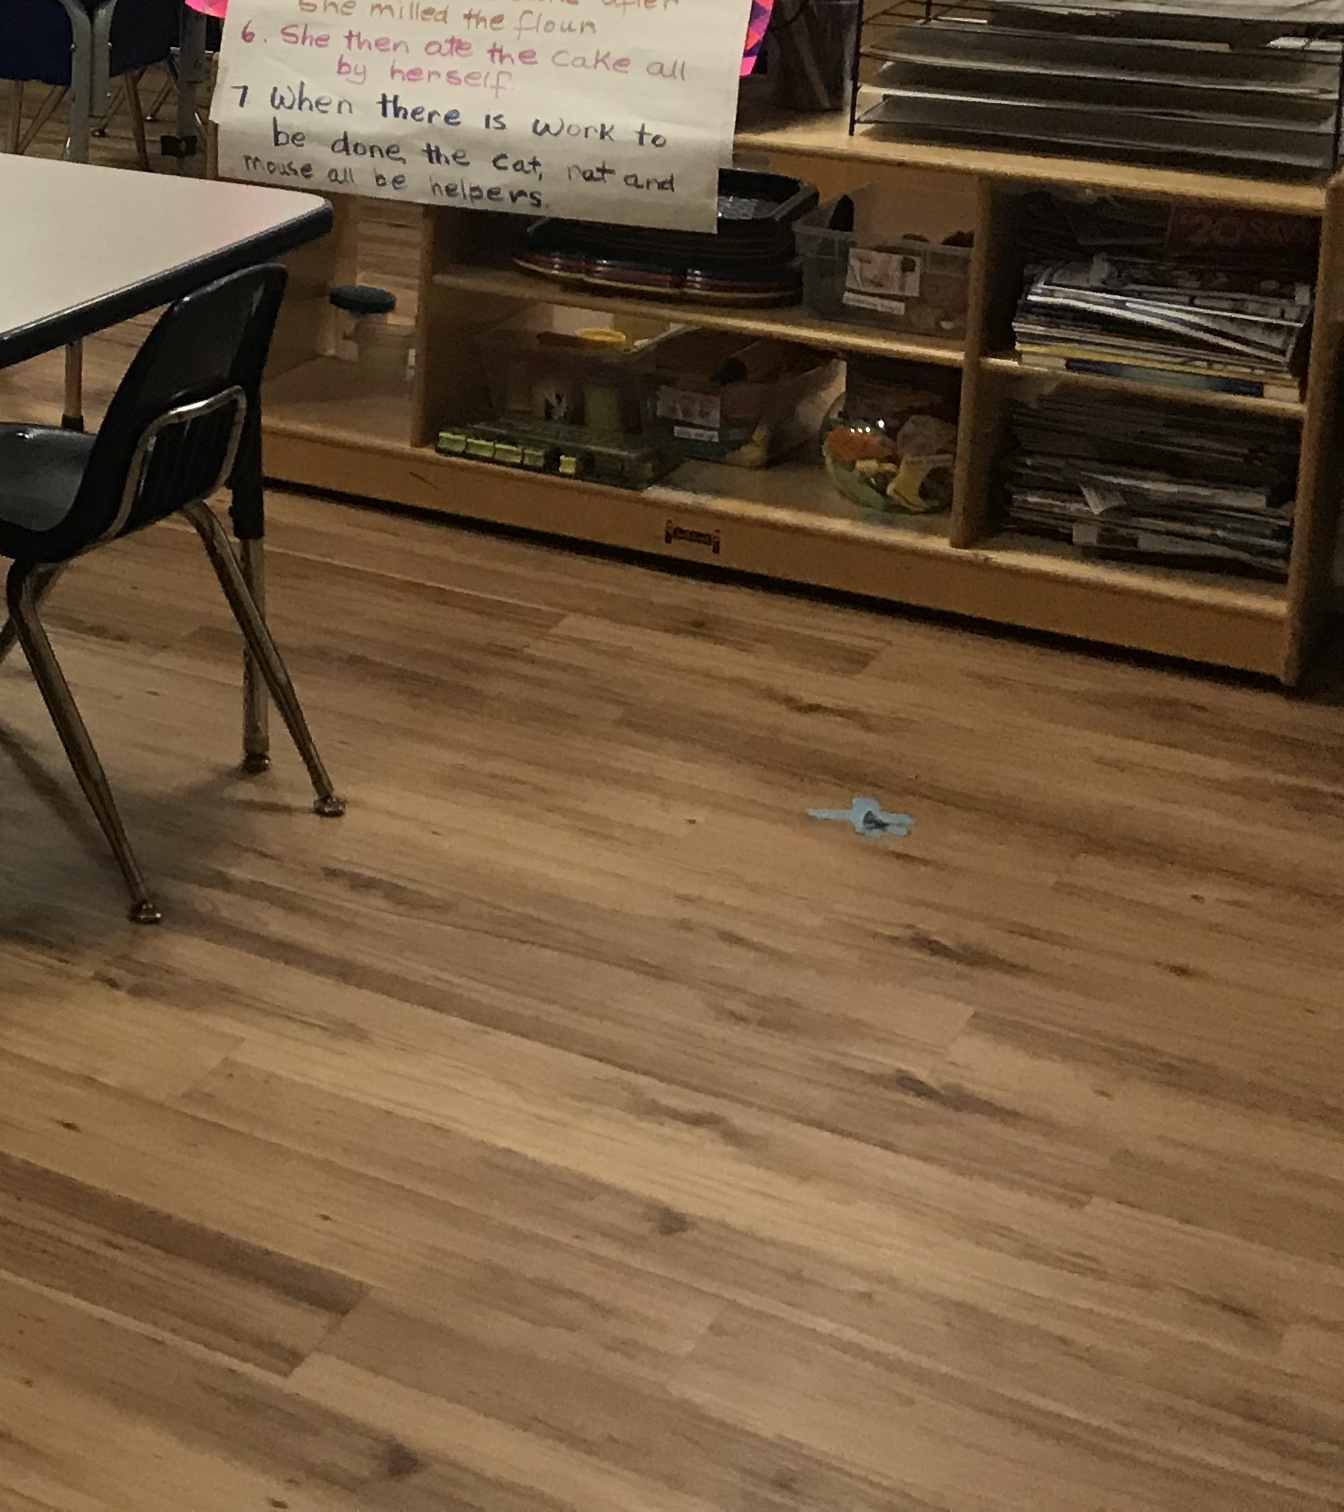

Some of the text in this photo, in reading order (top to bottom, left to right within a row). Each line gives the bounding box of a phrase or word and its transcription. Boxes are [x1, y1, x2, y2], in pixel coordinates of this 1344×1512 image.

[370, 0, 449, 24] milled
[463, 8, 504, 30] the
[280, 23, 331, 49] She
[344, 29, 409, 53] then
[424, 35, 473, 57] ate
[487, 41, 538, 65] the
[646, 59, 685, 81] all
[336, 54, 367, 85] by
[270, 80, 353, 115] When
[376, 92, 461, 126] there
[484, 112, 507, 131] is
[635, 122, 667, 148] to
[243, 154, 314, 178] mouse
[327, 167, 355, 185] all
[374, 168, 406, 190] be
[272, 116, 306, 147] be
[422, 142, 471, 167] the
[623, 172, 675, 192] and
